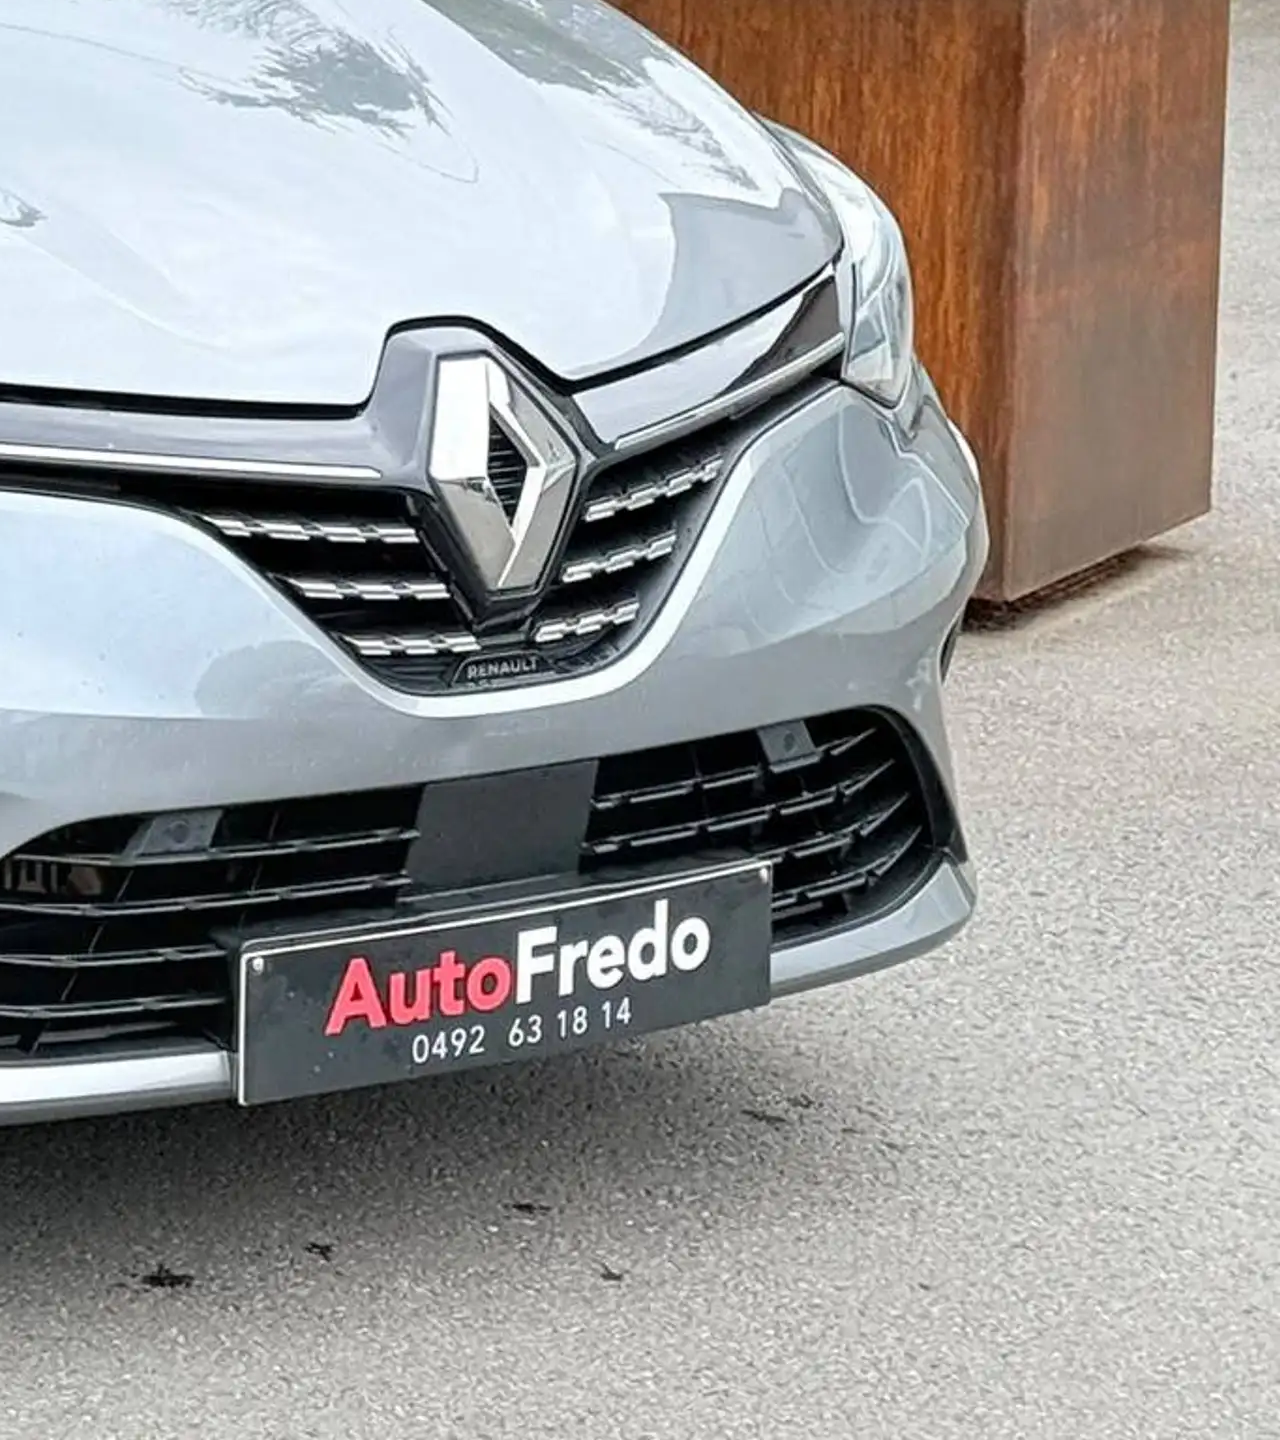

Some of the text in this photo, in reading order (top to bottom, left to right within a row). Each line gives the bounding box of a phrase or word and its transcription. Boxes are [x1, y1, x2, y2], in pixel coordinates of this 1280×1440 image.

[467, 656, 537, 678] RENAULT
[324, 898, 711, 1036] AutoFredo
[412, 997, 632, 1064] 0492 63 18 14
